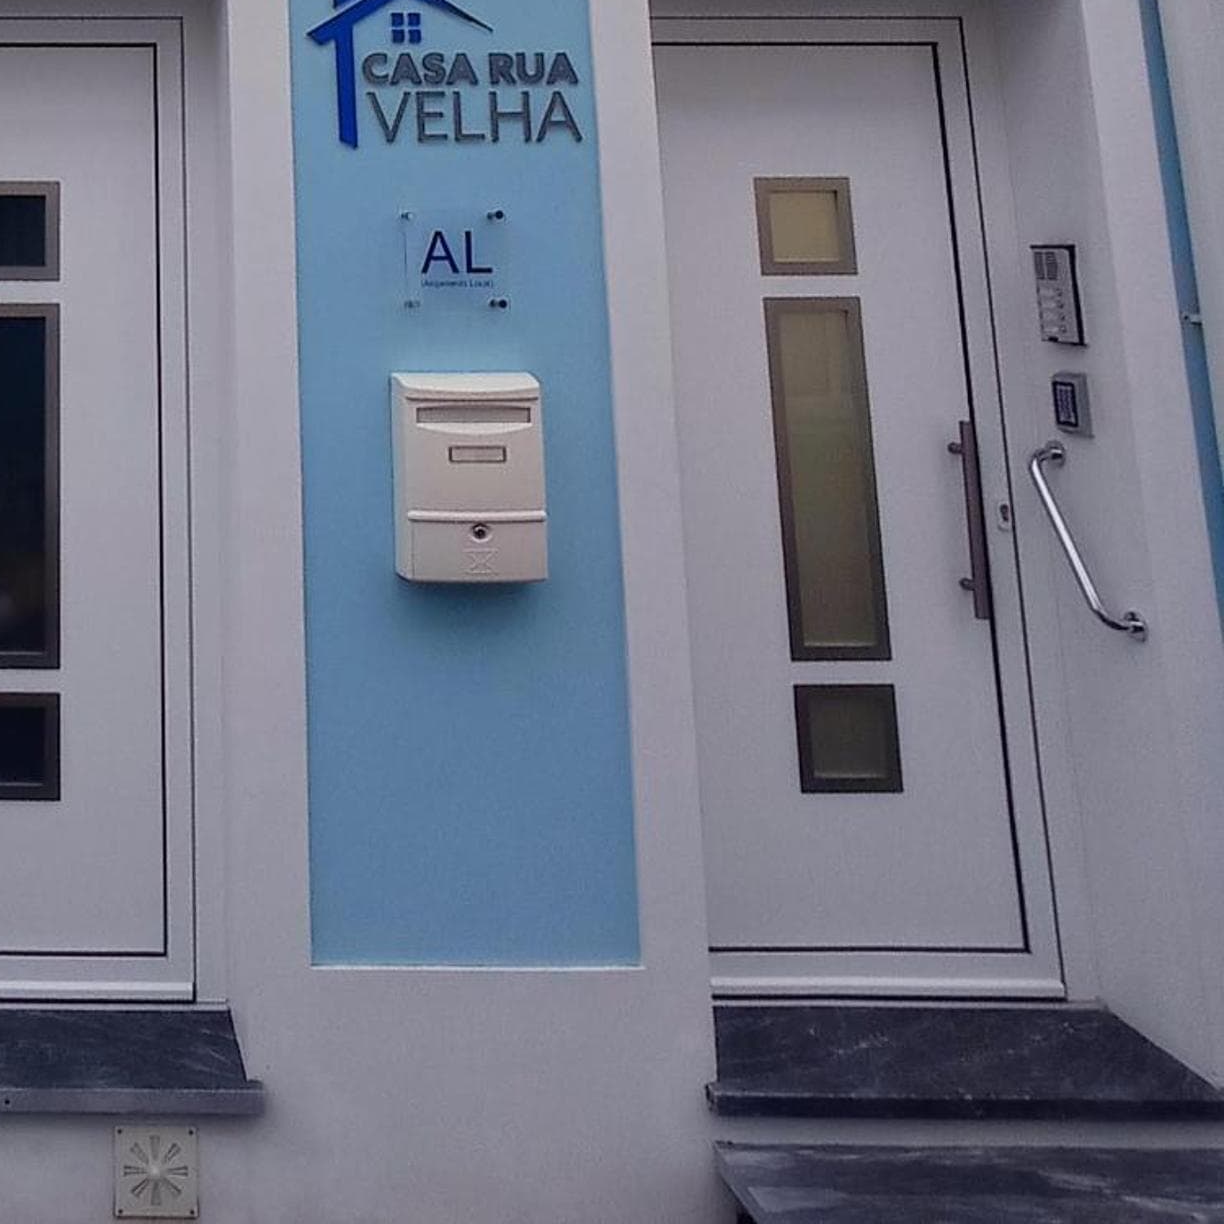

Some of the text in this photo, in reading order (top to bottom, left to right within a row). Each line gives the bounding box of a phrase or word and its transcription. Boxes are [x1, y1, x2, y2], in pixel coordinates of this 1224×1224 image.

[362, 52, 579, 85] CASA RUA
[366, 90, 583, 143] VELHA
[421, 230, 493, 274] AL
